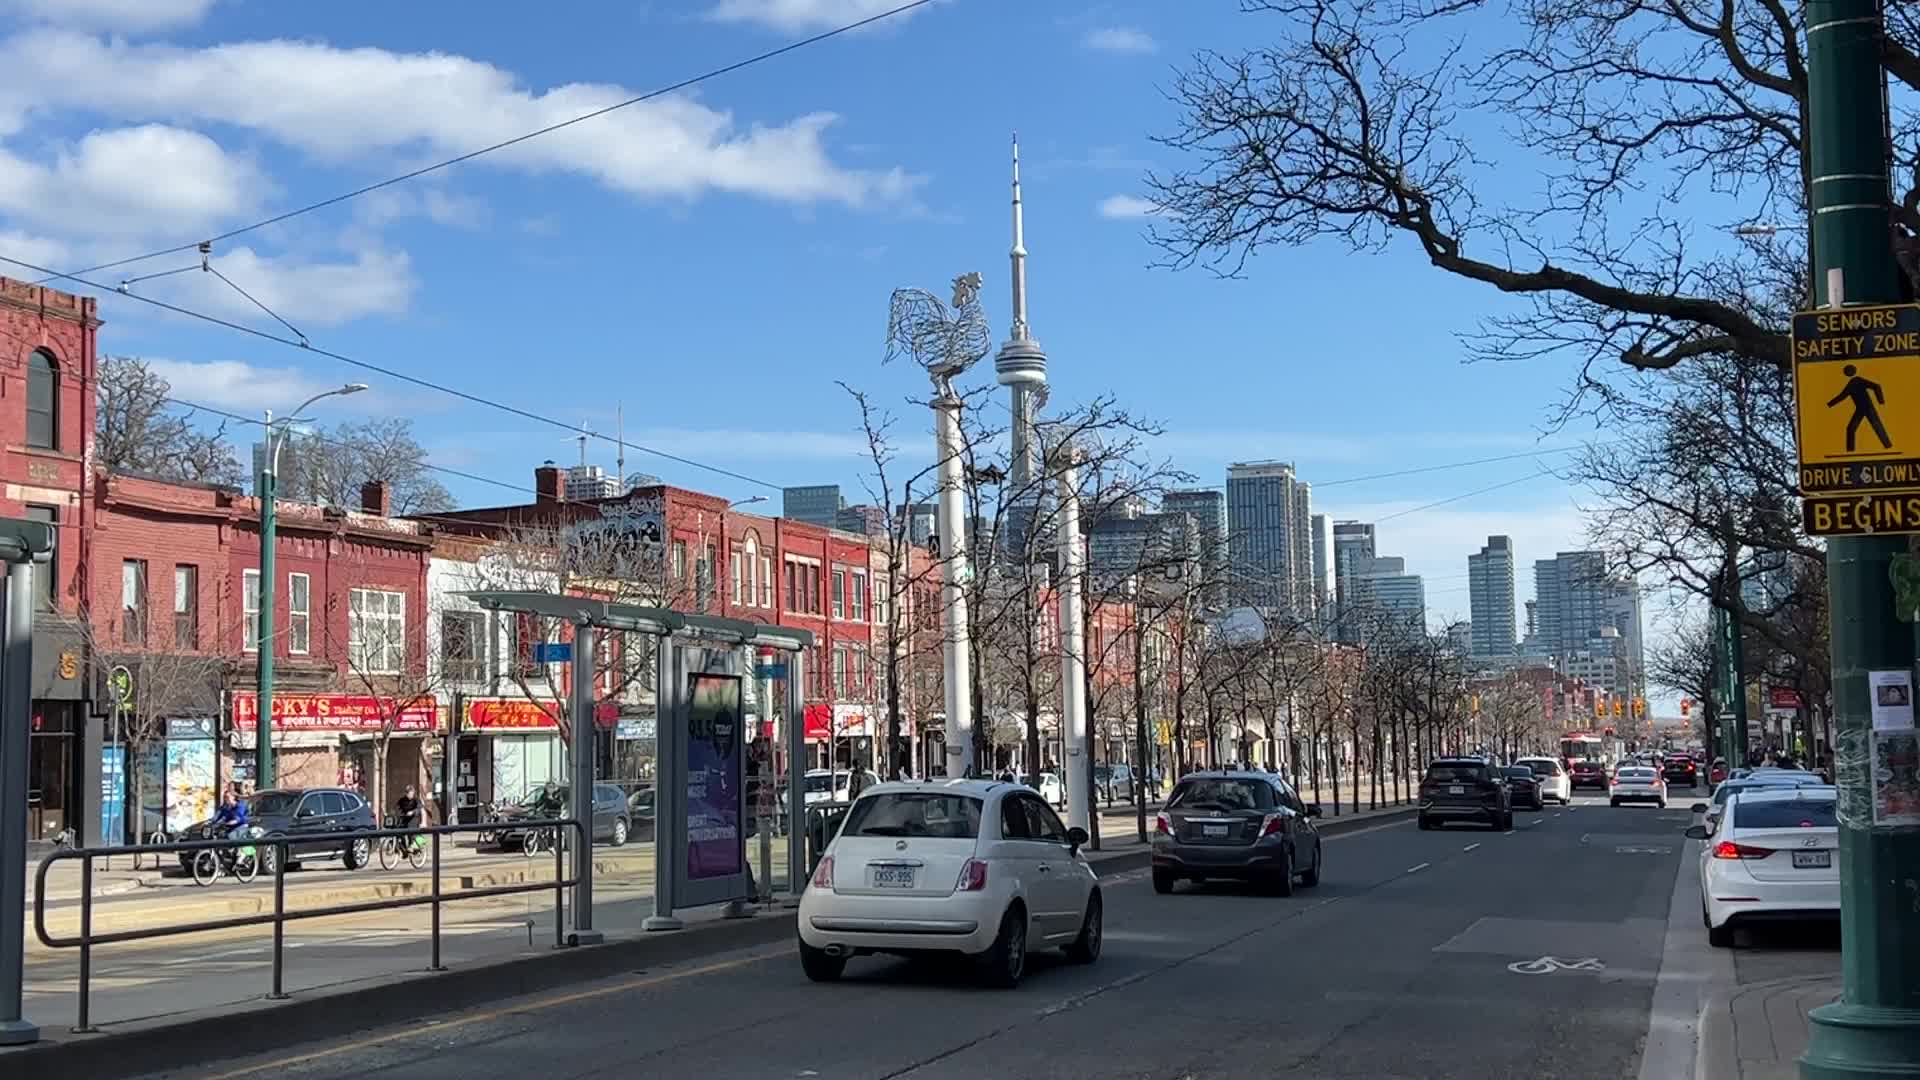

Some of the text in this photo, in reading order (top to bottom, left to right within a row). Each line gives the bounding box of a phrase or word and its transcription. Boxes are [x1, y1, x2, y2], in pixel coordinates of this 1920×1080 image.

[1816, 310, 1897, 333] SENIORS
[1797, 332, 1920, 357] SAFETY ZONE
[1803, 467, 1853, 487] DRIVE
